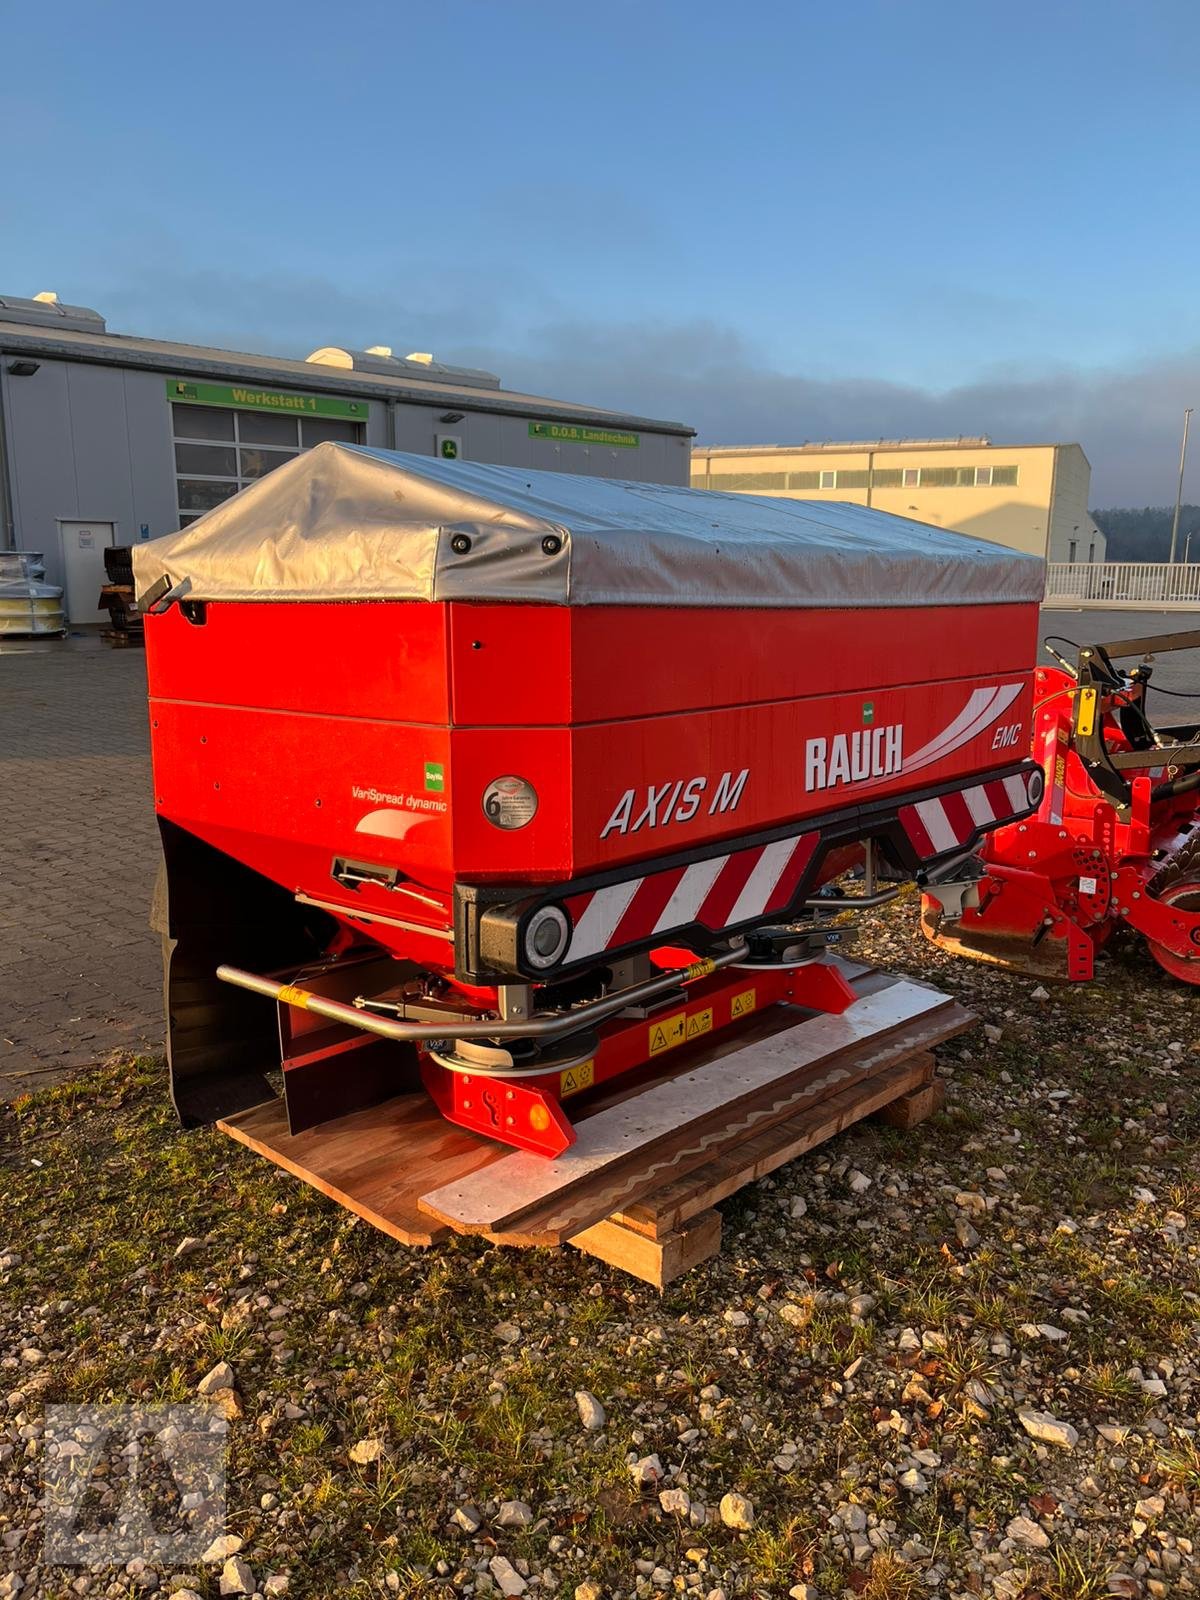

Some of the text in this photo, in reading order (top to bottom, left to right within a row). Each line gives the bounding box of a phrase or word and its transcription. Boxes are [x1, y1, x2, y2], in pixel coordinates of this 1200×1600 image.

[232, 388, 317, 410] Werkstatt 1
[551, 425, 637, 445] D.O.B. Landtechnik
[991, 723, 1023, 750] EMC
[805, 723, 904, 793] RAUCH
[352, 785, 448, 813] VariSpread dynamic
[485, 791, 501, 817] 6
[599, 768, 750, 840] AXIS M
